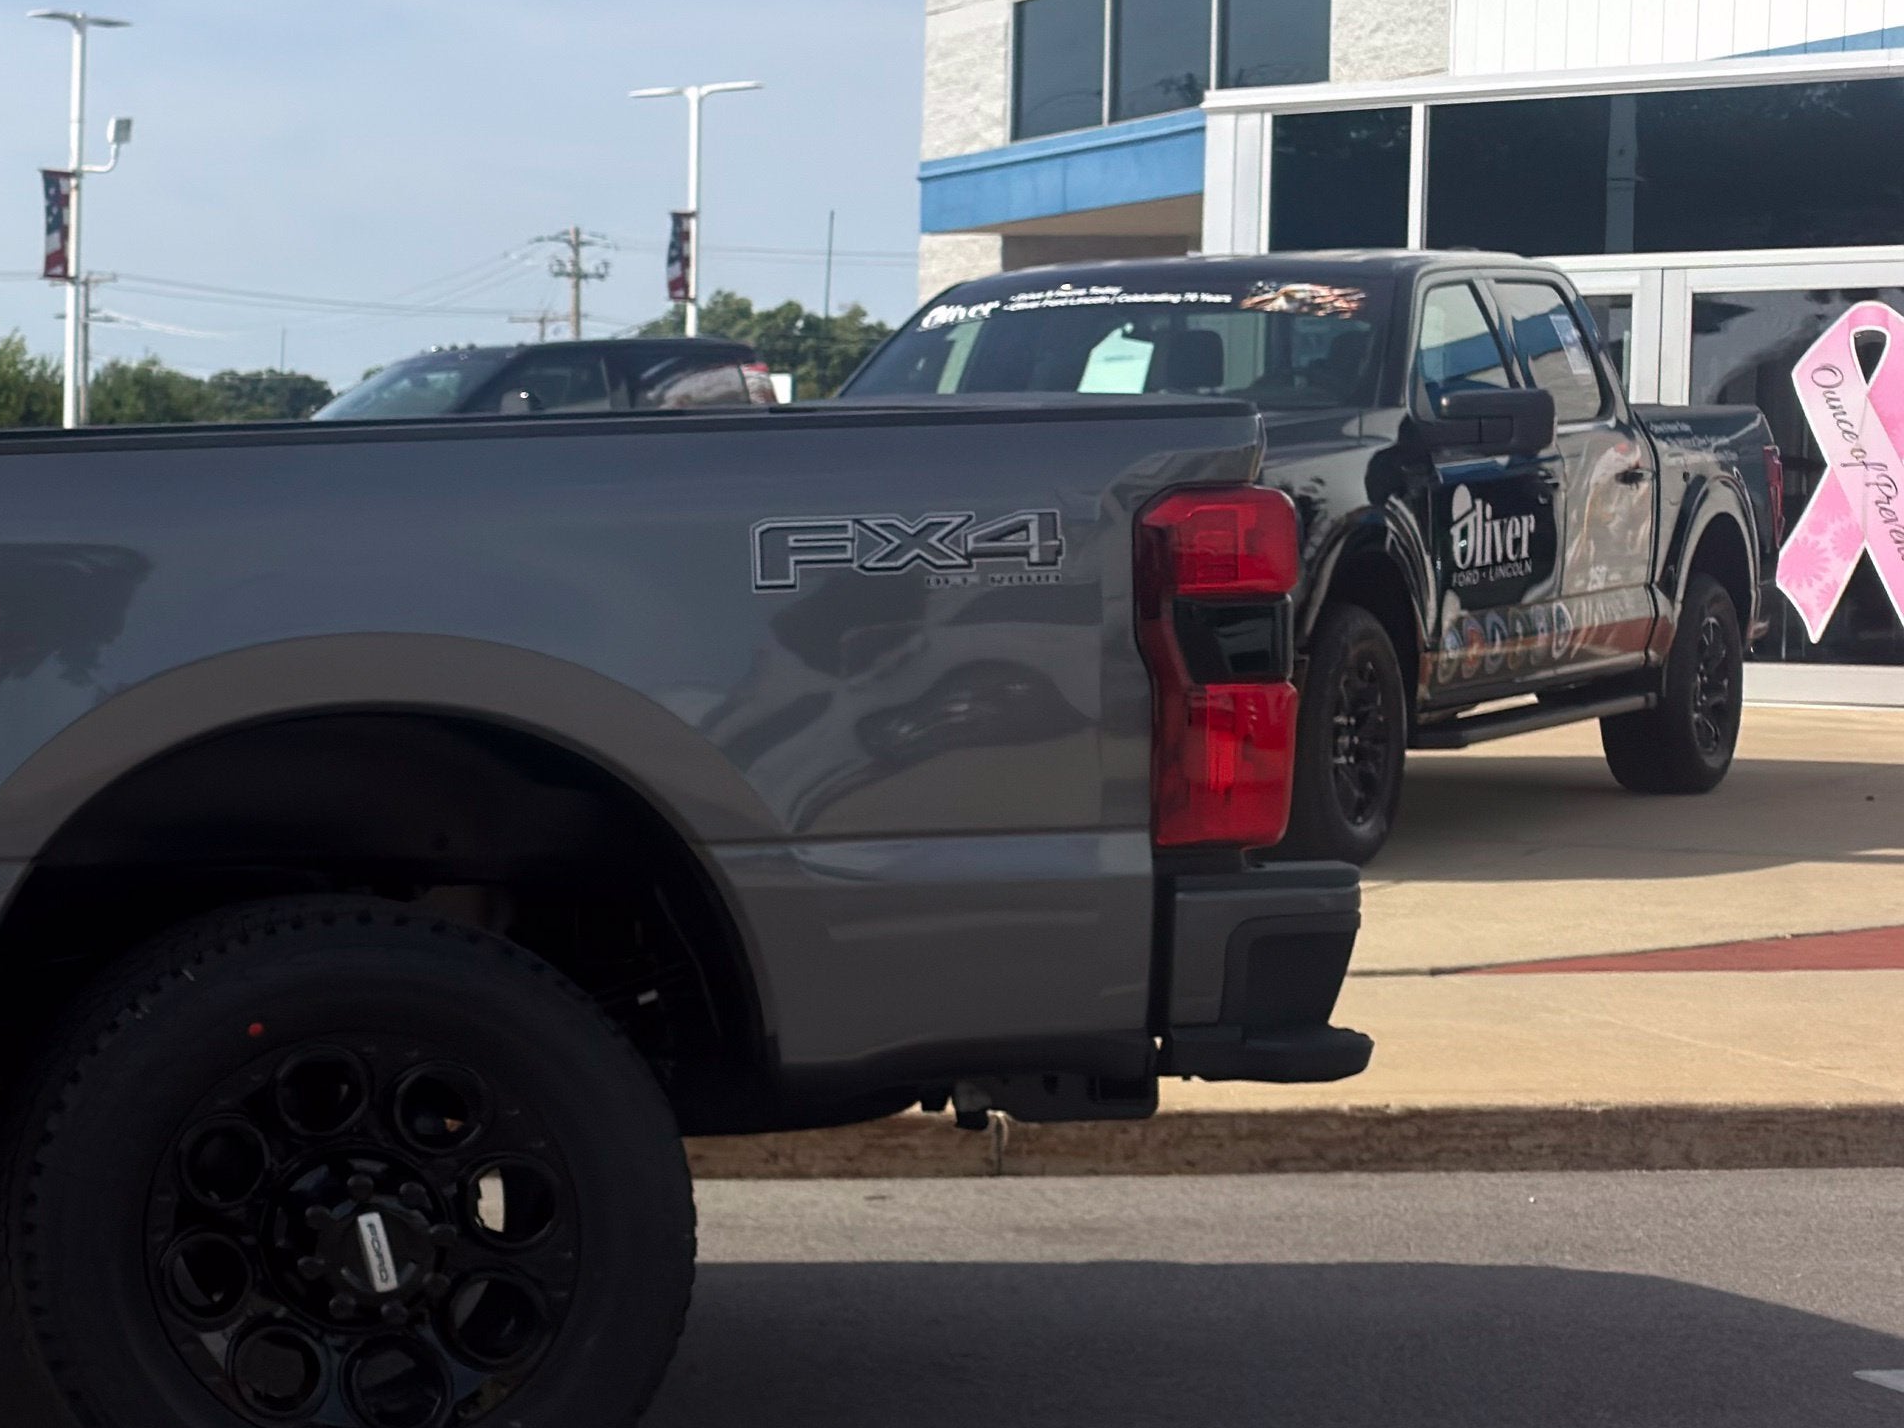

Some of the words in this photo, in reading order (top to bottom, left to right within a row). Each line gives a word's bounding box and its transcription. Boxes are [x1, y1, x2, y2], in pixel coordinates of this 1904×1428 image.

[1810, 363, 1859, 444] Ounce
[1840, 447, 1889, 472] of
[749, 508, 1066, 594] FX4
[1449, 483, 1536, 570] Oliver
[1452, 571, 1480, 587] FORD
[1489, 558, 1533, 582] LINCOLN
[365, 1222, 389, 1285] FORD
